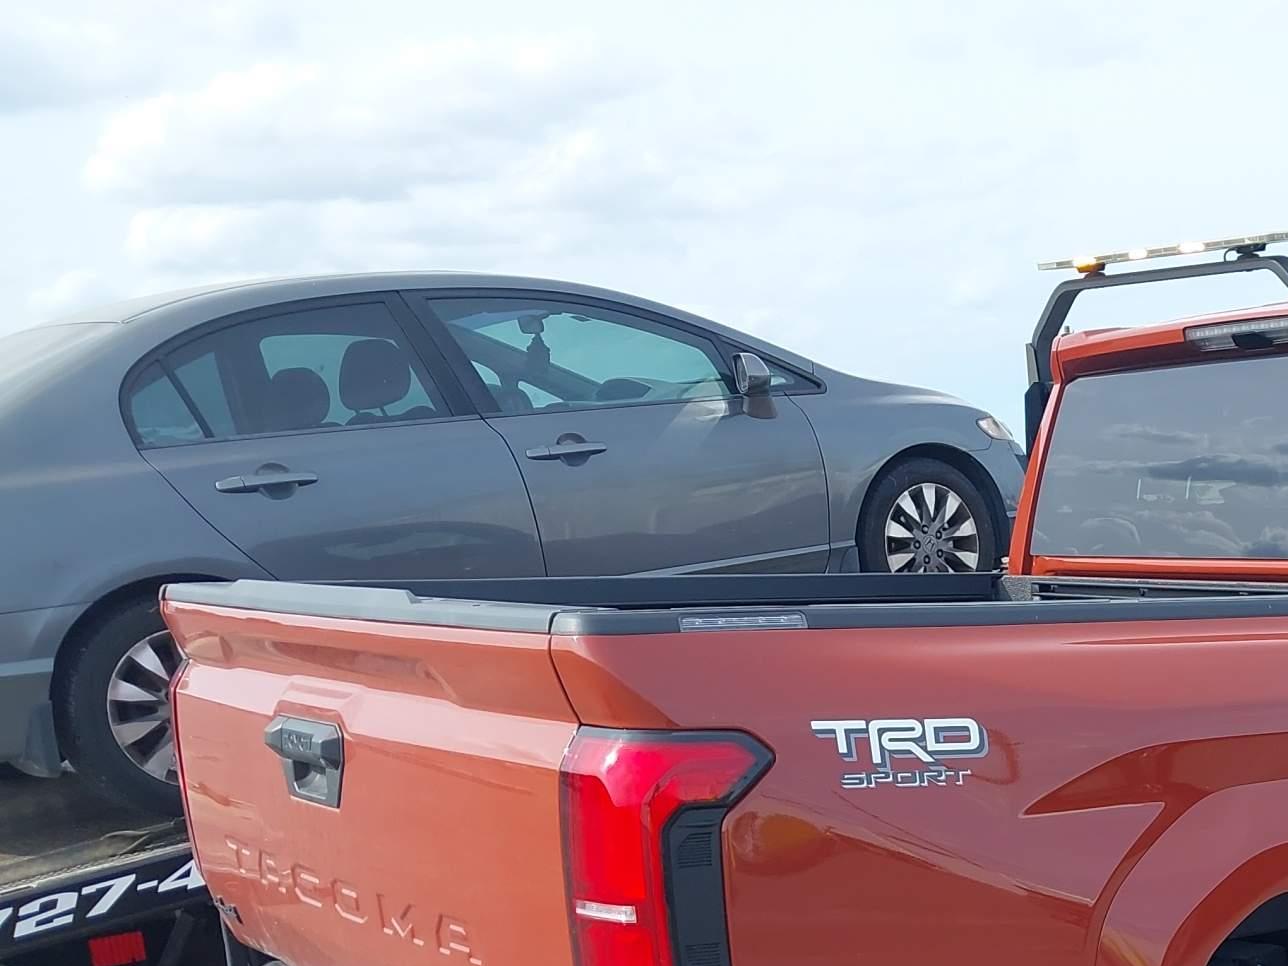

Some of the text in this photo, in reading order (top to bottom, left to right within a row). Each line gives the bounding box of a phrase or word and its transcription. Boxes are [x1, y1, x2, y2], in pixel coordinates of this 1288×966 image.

[811, 718, 988, 771] TRD
[841, 769, 971, 788] SPORT
[0, 859, 206, 938] 27-4
[225, 835, 482, 965] TACOMA
